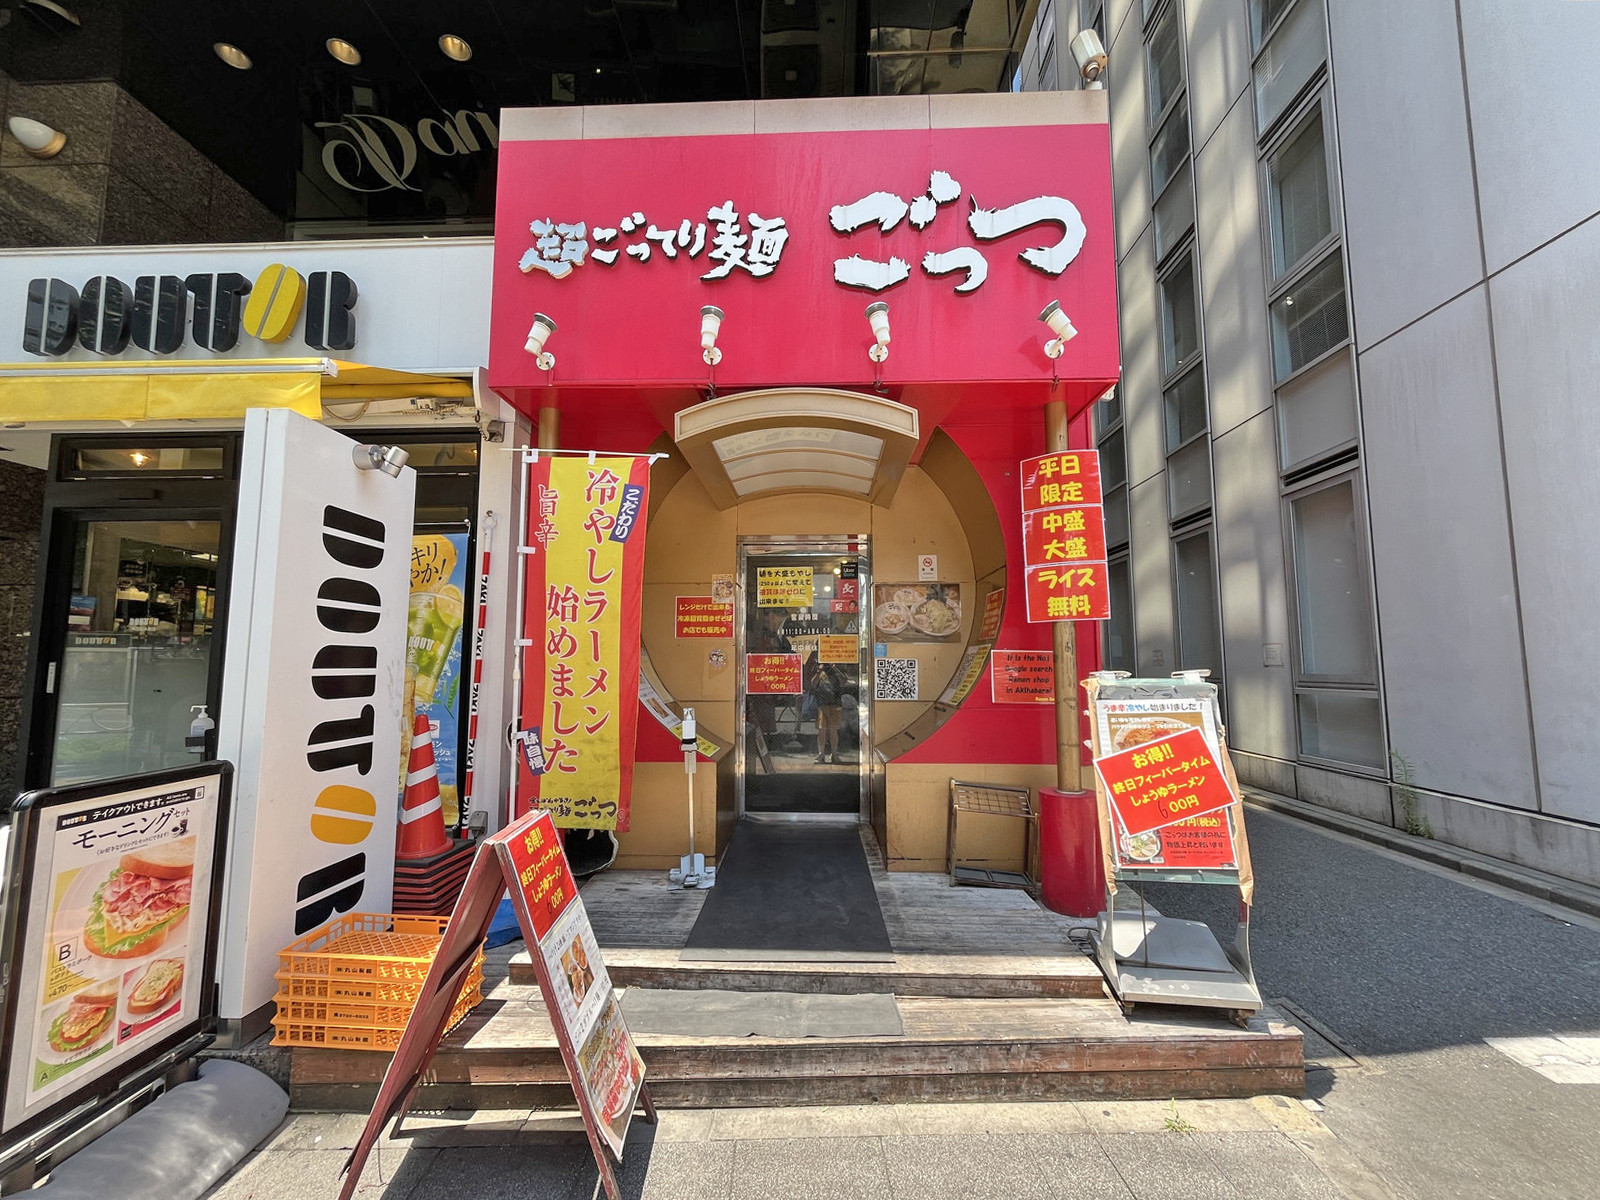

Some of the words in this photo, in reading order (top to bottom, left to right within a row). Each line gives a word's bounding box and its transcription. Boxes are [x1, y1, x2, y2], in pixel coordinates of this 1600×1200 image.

[829, 170, 1088, 294] ごっつ
[23, 262, 360, 356] DOUTOR
[1038, 455, 1081, 478] 平日
[1040, 482, 1084, 505] 限定
[534, 484, 560, 549] 旨辛
[614, 487, 641, 540] こだわり
[1042, 510, 1086, 533] 中盛
[1043, 537, 1088, 561] 大盛
[1037, 567, 1096, 589] ライス
[582, 468, 621, 735] 冷やしラーメン
[1047, 594, 1090, 617] 無料
[75, 637, 117, 645] DOUTOR
[543, 584, 580, 774] 始めました
[293, 503, 387, 937] DOUTOR
[1131, 743, 1175, 769] お得!!
[1112, 755, 1211, 795] 終日フィーバータイム
[1130, 776, 1206, 807] しょうゆラーメン
[574, 796, 617, 819] ごっつ
[72, 808, 175, 849] モーニング
[58, 943, 72, 961] B
[40, 1072, 48, 1082] A
